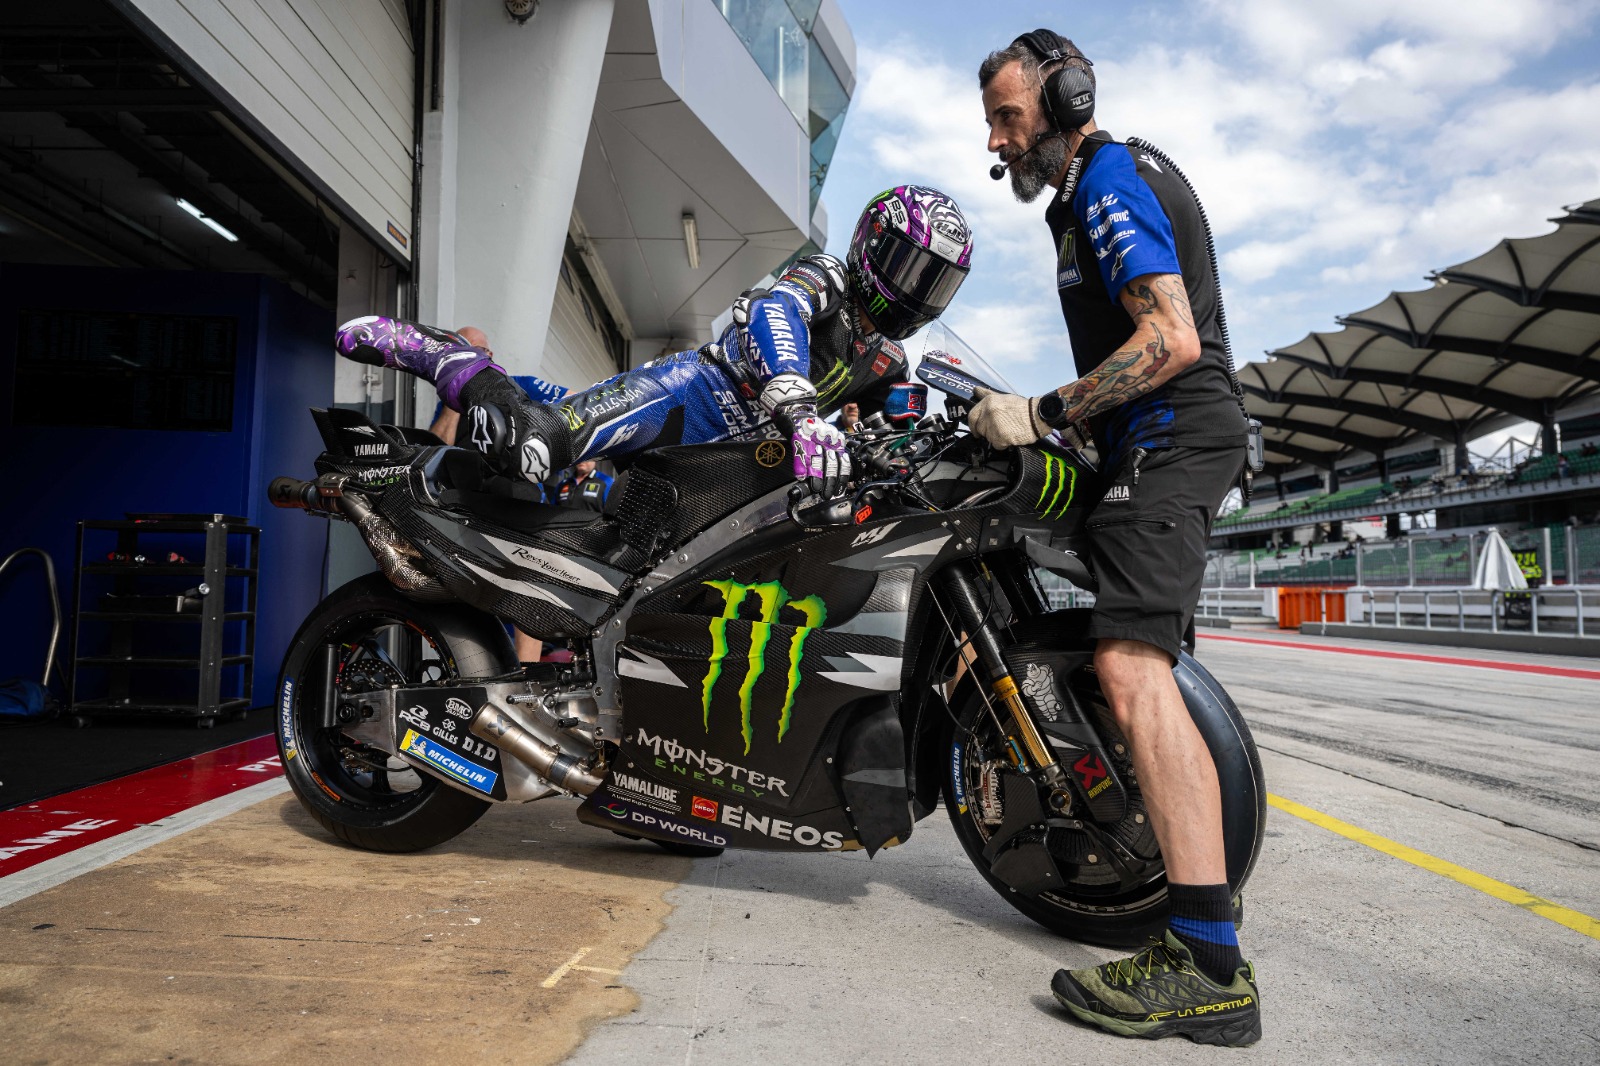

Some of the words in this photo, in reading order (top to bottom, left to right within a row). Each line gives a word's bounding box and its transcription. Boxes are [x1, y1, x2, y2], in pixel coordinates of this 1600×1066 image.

[1064, 157, 1081, 193] YAMAHA
[763, 303, 799, 362] YAMAHA
[585, 387, 645, 418] MONSTER
[354, 443, 389, 457] YAMAHA
[358, 464, 411, 482] MONSTER
[511, 546, 542, 563] Revs
[284, 680, 293, 739] MICHELIN
[399, 710, 431, 732] RCB
[447, 699, 471, 718] BMC
[432, 726, 459, 745] GILLES
[461, 735, 497, 762] D.I.D
[427, 749, 487, 784] MICHELIN
[637, 727, 790, 798] MONSTER
[654, 757, 766, 798] ENERGY
[953, 747, 963, 796] MICHELIN
[612, 770, 677, 804] YAMALUBE
[631, 811, 657, 826] DP
[657, 819, 727, 846] WORLD
[721, 804, 845, 850] ENEOS
[1177, 1008, 1193, 1018] LA
[1195, 996, 1253, 1015] SPORTIVA
